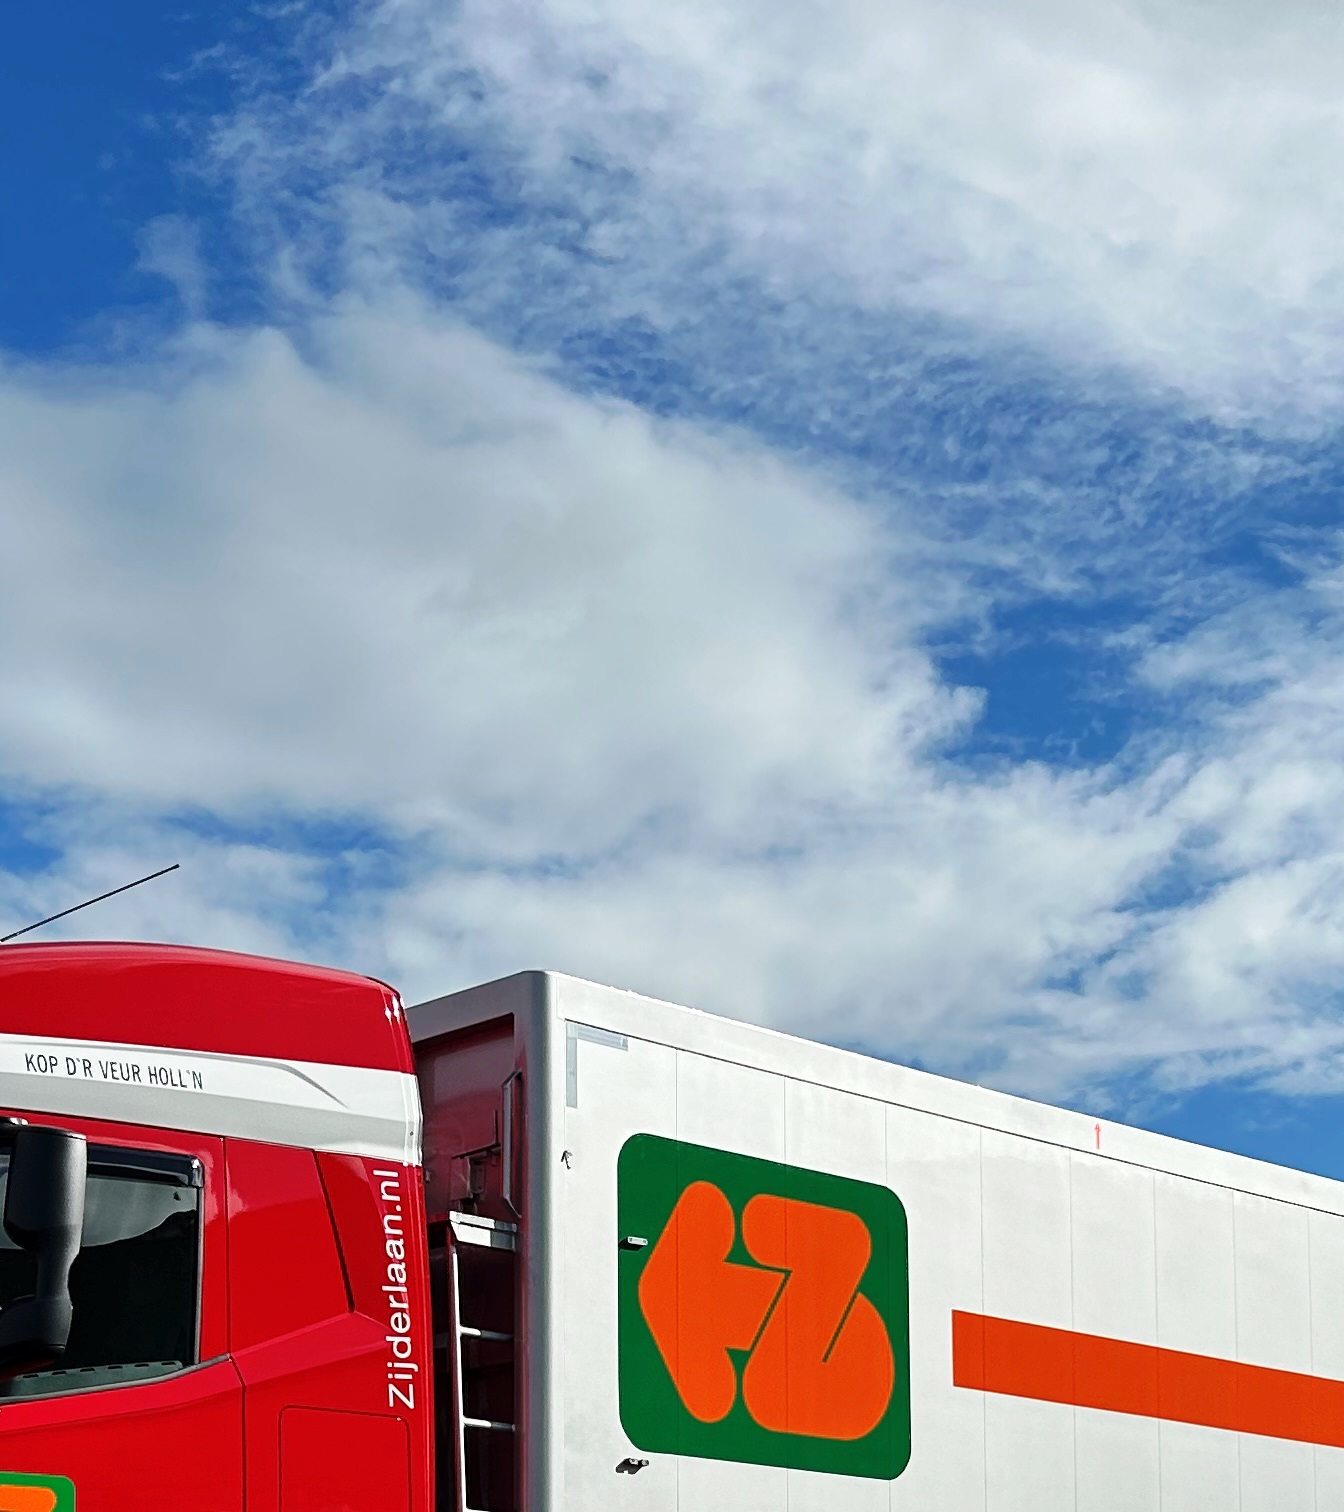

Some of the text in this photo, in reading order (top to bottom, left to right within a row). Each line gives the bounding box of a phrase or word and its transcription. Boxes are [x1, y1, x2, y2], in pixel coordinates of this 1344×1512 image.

[24, 1053, 58, 1073] KOP
[98, 1060, 142, 1083] VEUR
[372, 1169, 419, 1410] Zijderlaan.nl
